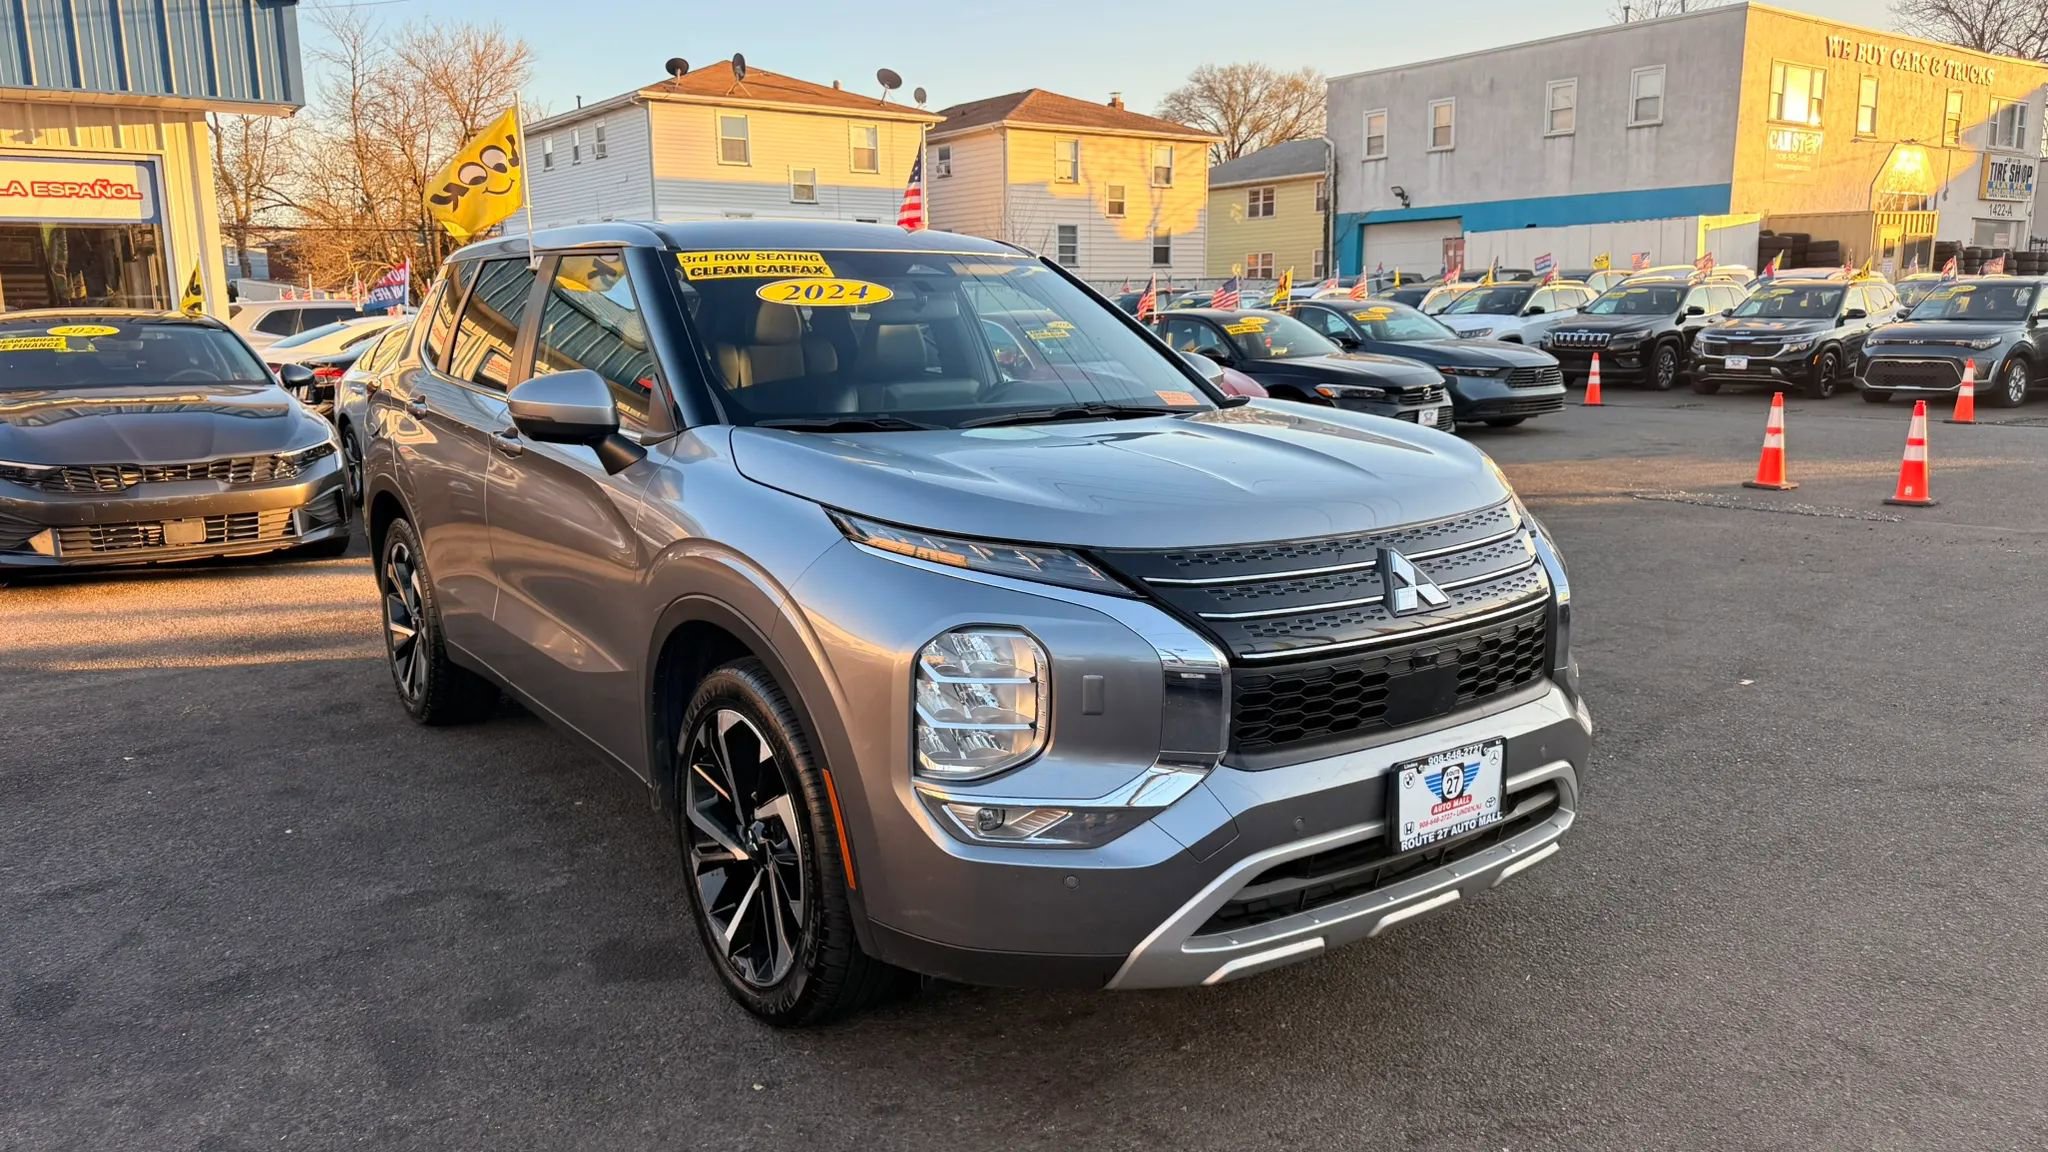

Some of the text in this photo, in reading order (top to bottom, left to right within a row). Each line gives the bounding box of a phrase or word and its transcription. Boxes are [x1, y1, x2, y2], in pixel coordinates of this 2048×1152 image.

[1826, 35, 1995, 86] WE BUY CARS & TRUCKS
[1990, 162, 2033, 184] TIRE SHOP
[31, 178, 143, 200] ESPAÑOL
[1989, 203, 2012, 216] 1422-A
[682, 252, 820, 264] 3rd ROW SEATING
[690, 265, 826, 277] CLEAN CARFAX
[783, 284, 869, 301] 2024
[1446, 776, 1460, 795] 27
[1433, 797, 1470, 813] AUTO MALL
[1401, 811, 1503, 852] ROUTE 27 AUTO MALL
